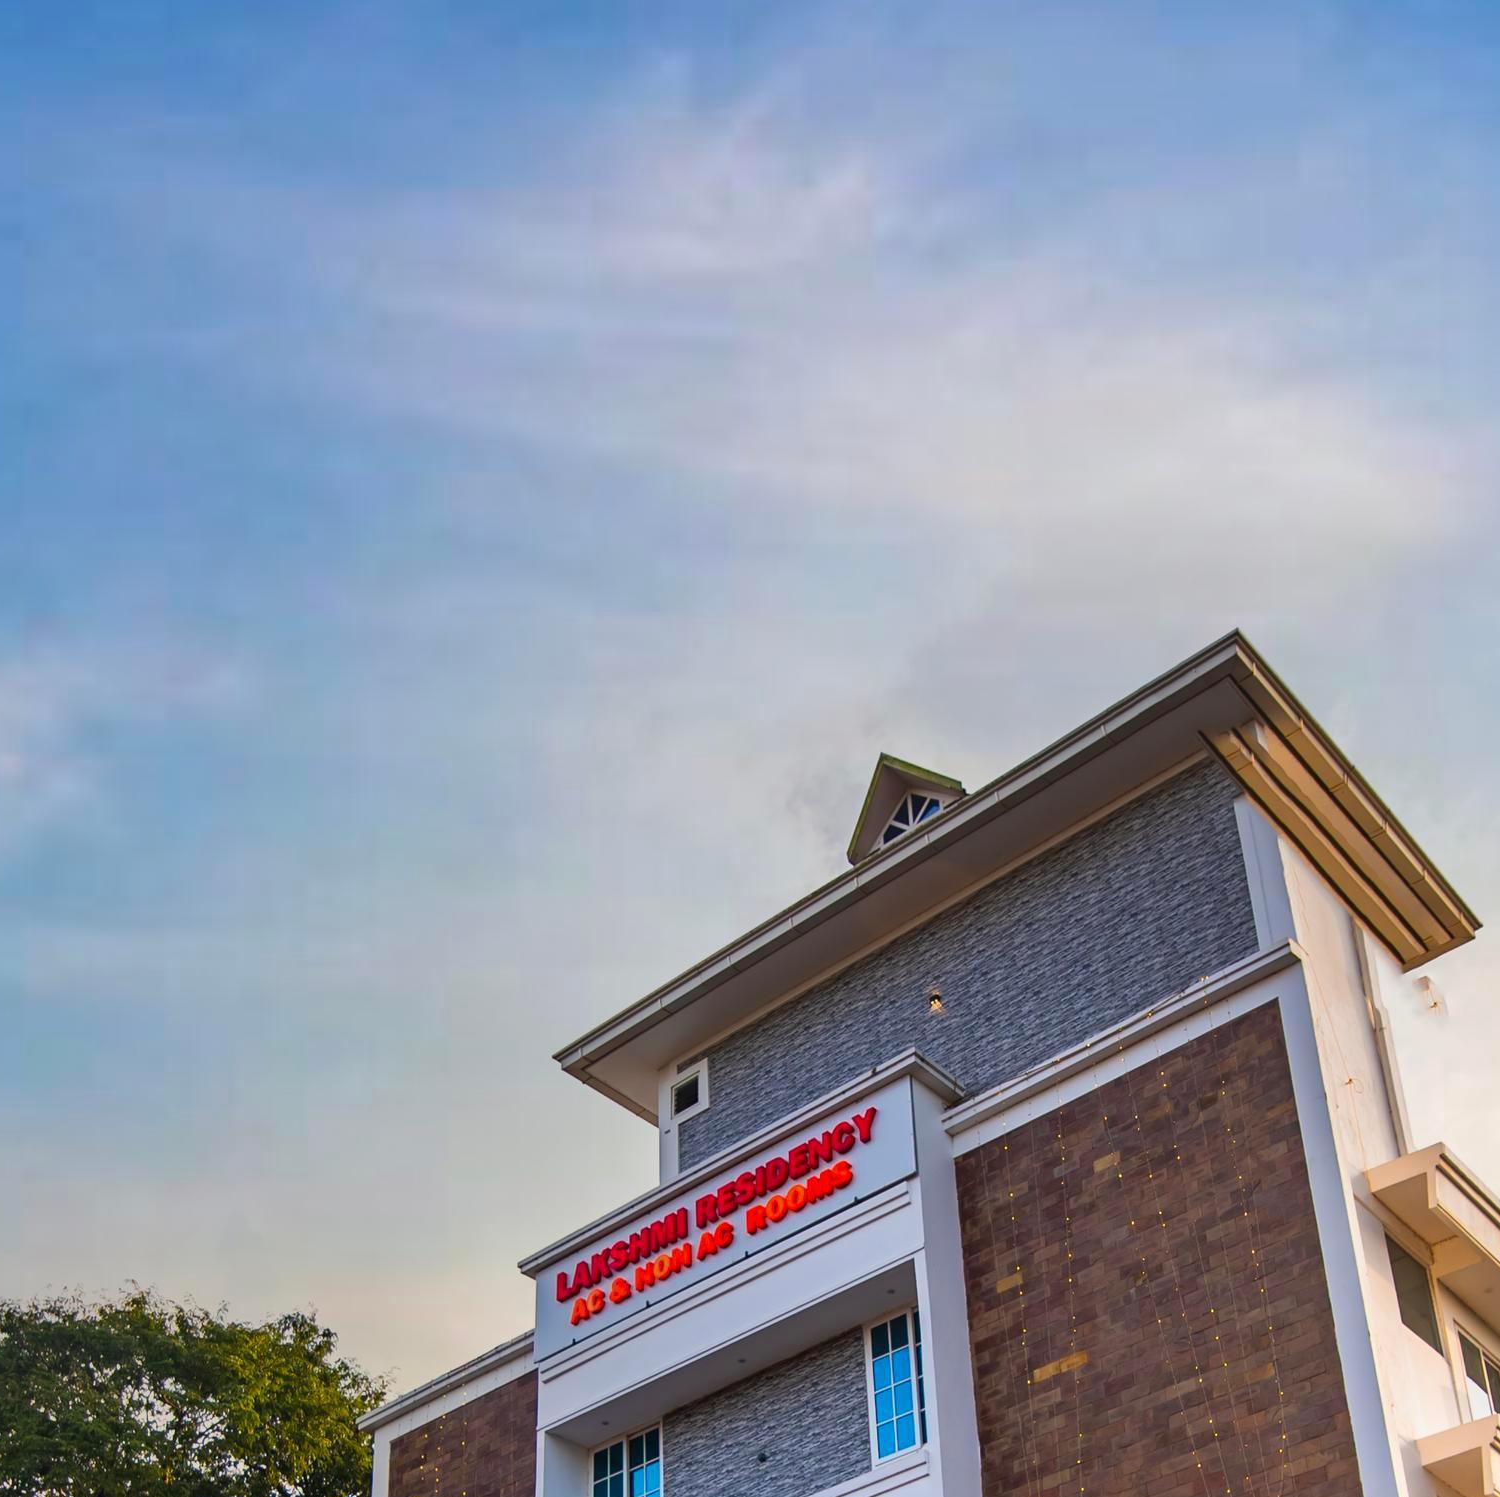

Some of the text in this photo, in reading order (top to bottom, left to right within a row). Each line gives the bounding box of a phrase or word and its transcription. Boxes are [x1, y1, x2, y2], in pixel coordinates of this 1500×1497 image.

[556, 1107, 877, 1303] LAKSHMI RESIDENCY
[569, 1160, 854, 1326] AC & NON AC ROOMS
